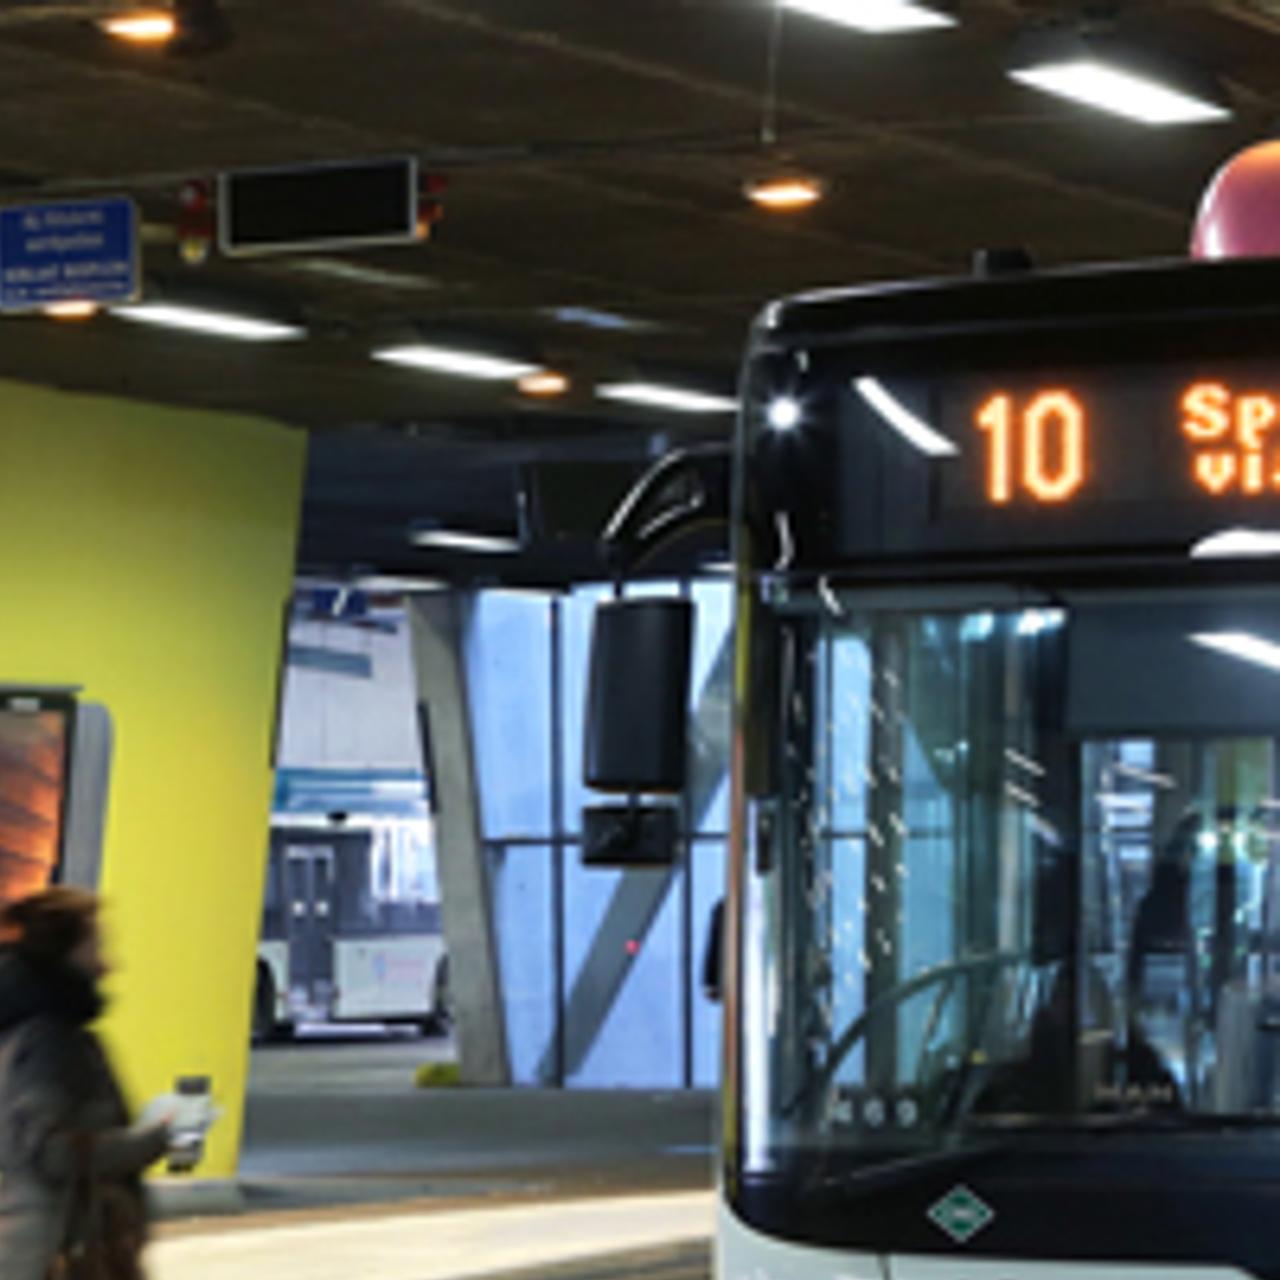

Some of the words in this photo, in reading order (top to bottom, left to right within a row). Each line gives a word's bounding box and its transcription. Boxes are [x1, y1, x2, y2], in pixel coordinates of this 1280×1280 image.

[974, 388, 1085, 503] 10
[1181, 380, 1276, 450] Sp
[1195, 452, 1280, 495] vi
